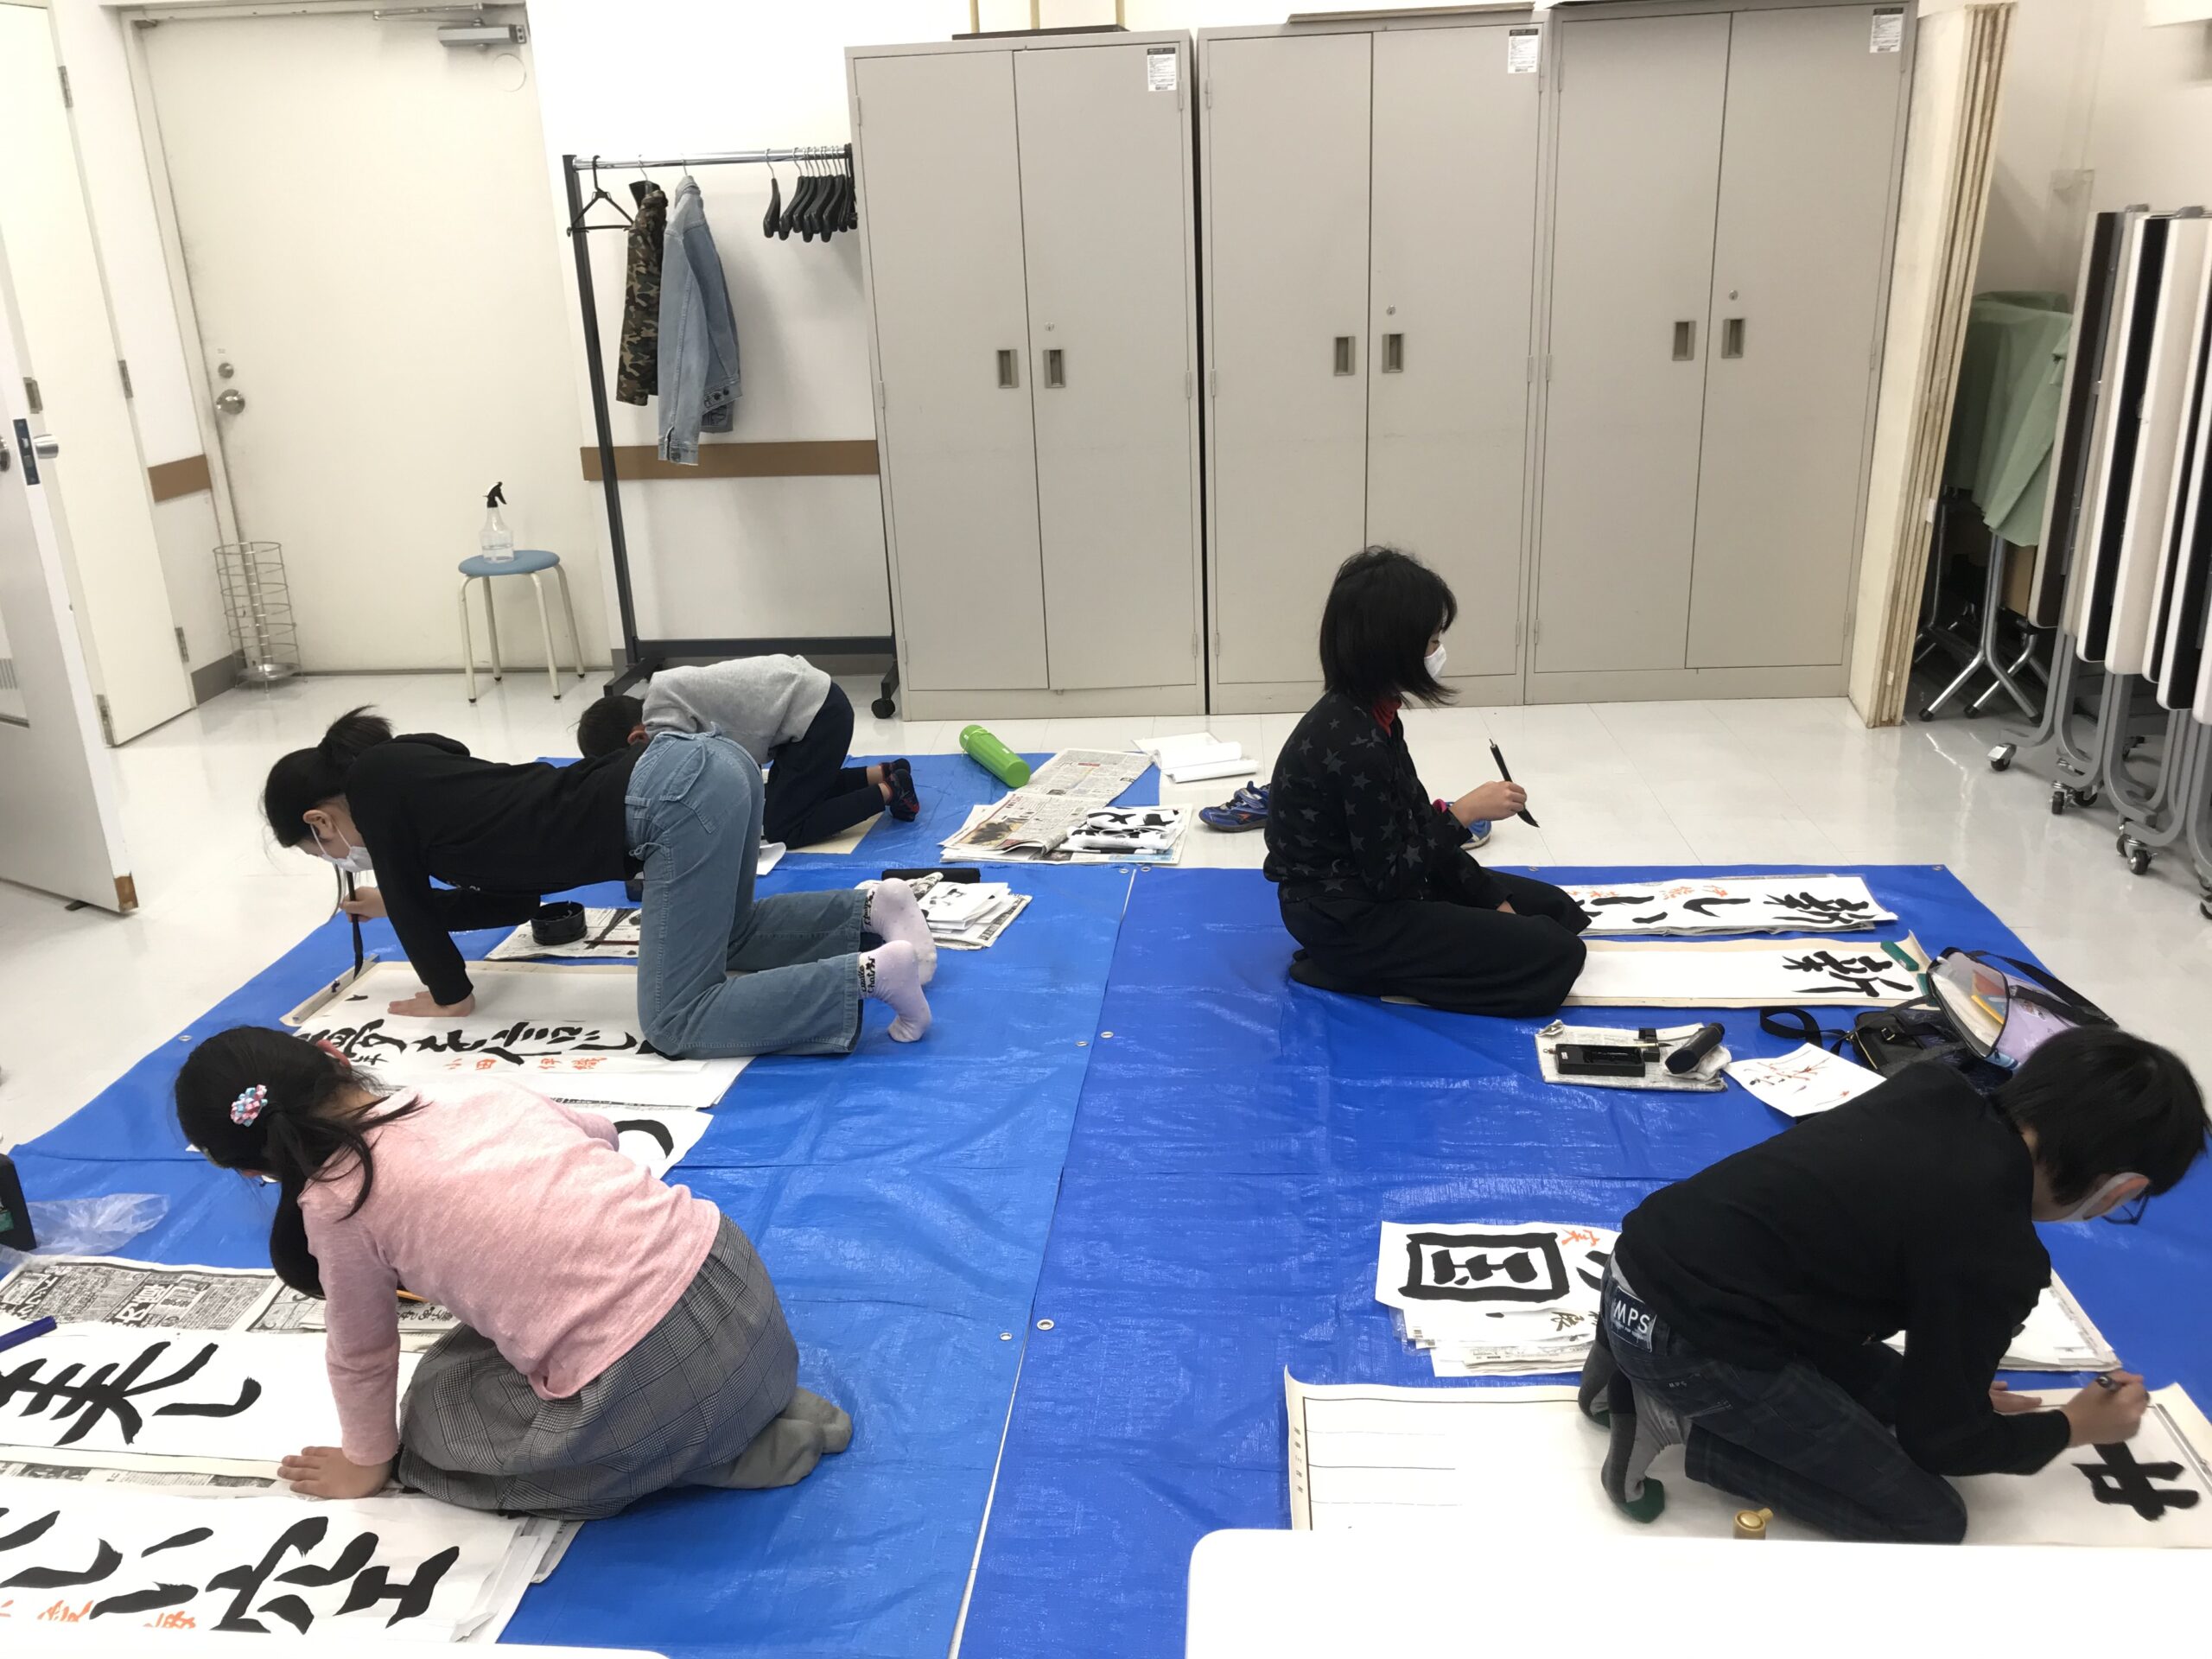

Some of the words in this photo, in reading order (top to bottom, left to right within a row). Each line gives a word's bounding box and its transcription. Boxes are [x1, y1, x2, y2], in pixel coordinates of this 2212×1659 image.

[1576, 892, 1881, 925] 新しい
[1782, 950, 1914, 997] 新
[294, 1018, 683, 1065] 夢を信じ
[1613, 1300, 1650, 1333] MPS
[0, 1506, 459, 1635] しい空
